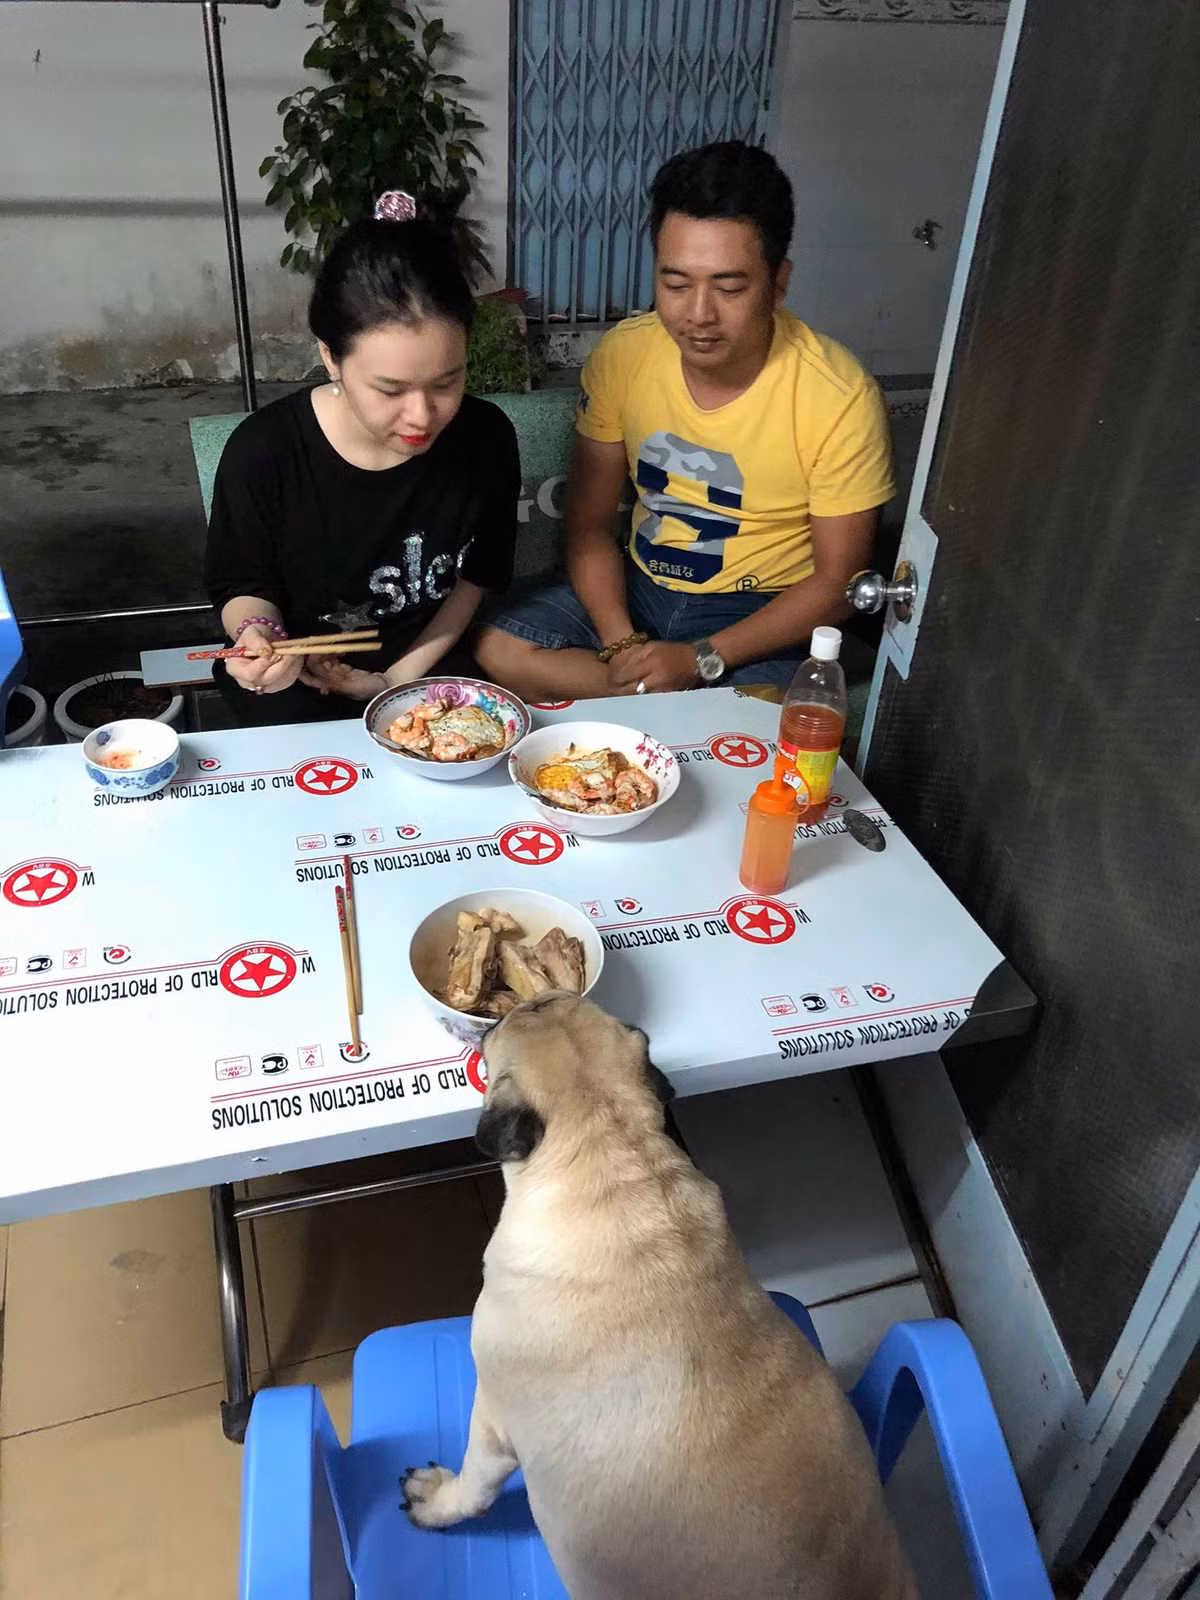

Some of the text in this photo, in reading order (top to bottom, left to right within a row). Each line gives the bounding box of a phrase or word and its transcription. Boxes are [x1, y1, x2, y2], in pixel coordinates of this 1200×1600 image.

[675, 752, 689, 763] OF
[171, 780, 244, 799] PROTECTION
[252, 779, 265, 790] OF
[374, 850, 450, 871] PROTECTION
[457, 847, 471, 860] OF
[296, 862, 368, 883] SOUTIONS
[601, 926, 679, 951] PROTECTION
[684, 924, 700, 939] OF
[67, 978, 156, 1005] PROTECTION
[166, 975, 182, 992] OF
[779, 1011, 961, 1059] OF PROTECTION SOLUTIONS
[412, 1074, 430, 1094] OF
[310, 1079, 404, 1112] PROTECTION
[212, 1096, 301, 1129] SOLUTIONS
